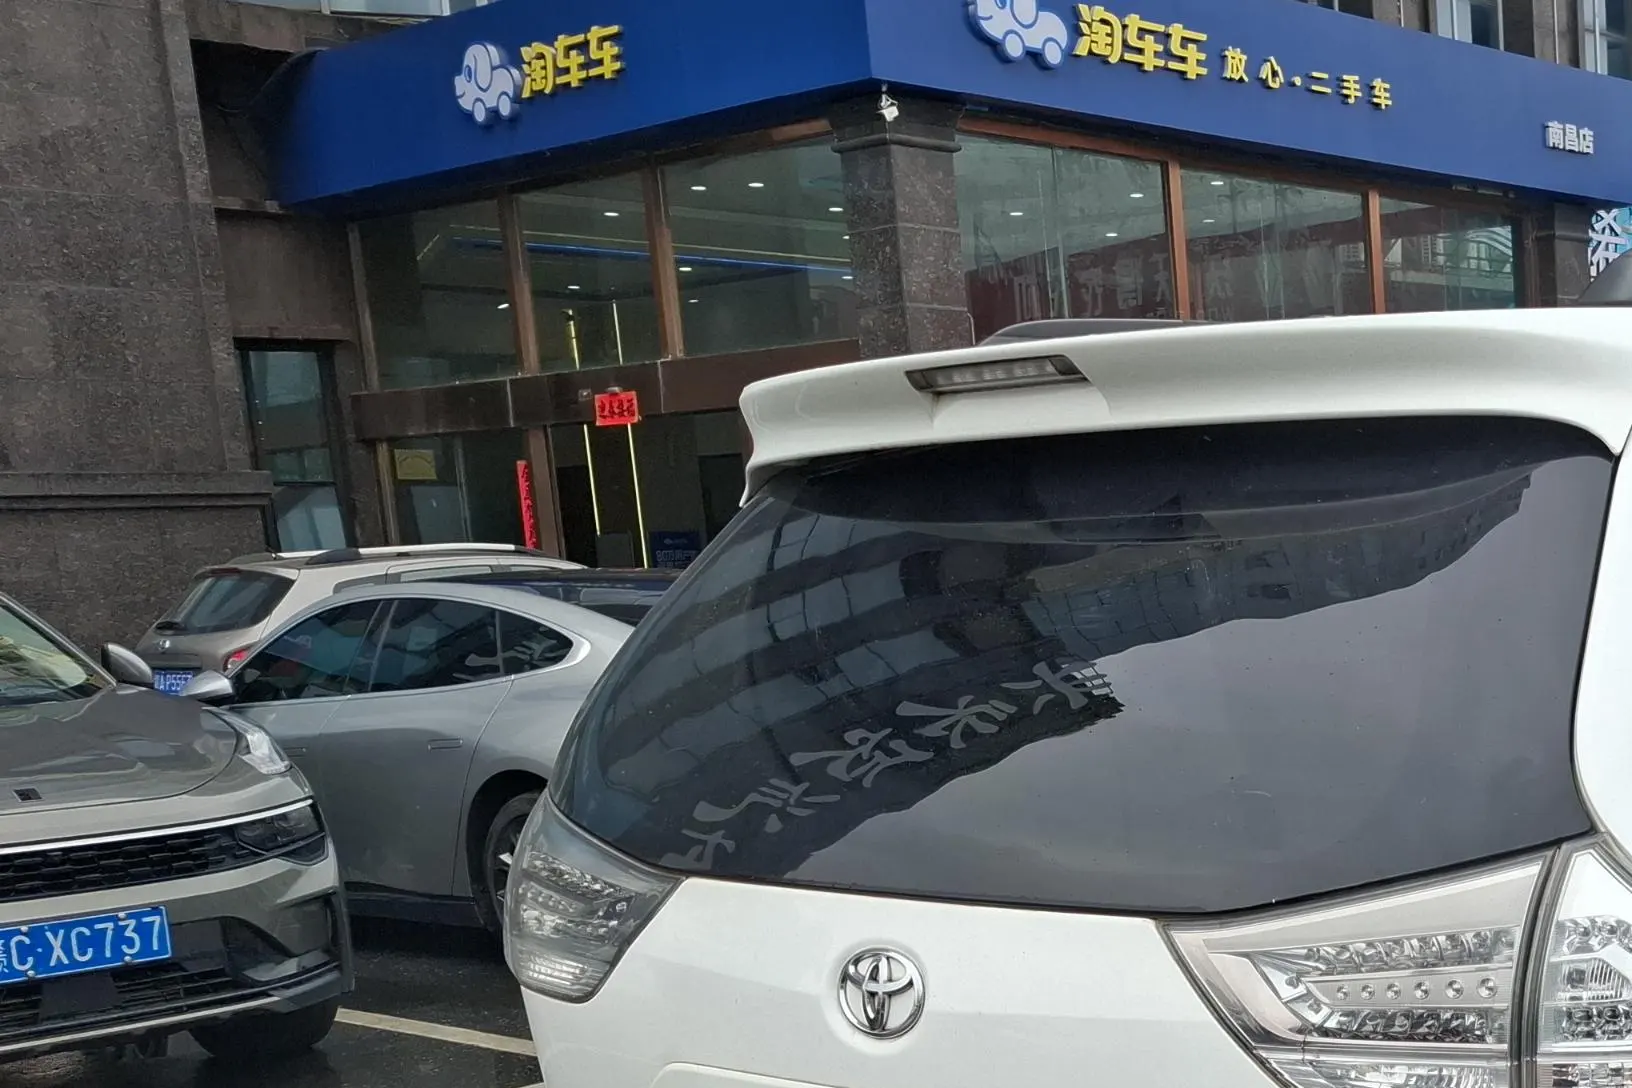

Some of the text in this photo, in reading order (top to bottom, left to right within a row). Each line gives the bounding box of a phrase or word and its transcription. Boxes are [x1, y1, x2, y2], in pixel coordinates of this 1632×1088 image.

[520, 25, 623, 98] 淘车车
[1072, 4, 1208, 79] 淘车车
[1545, 120, 1594, 154] 南昌店
